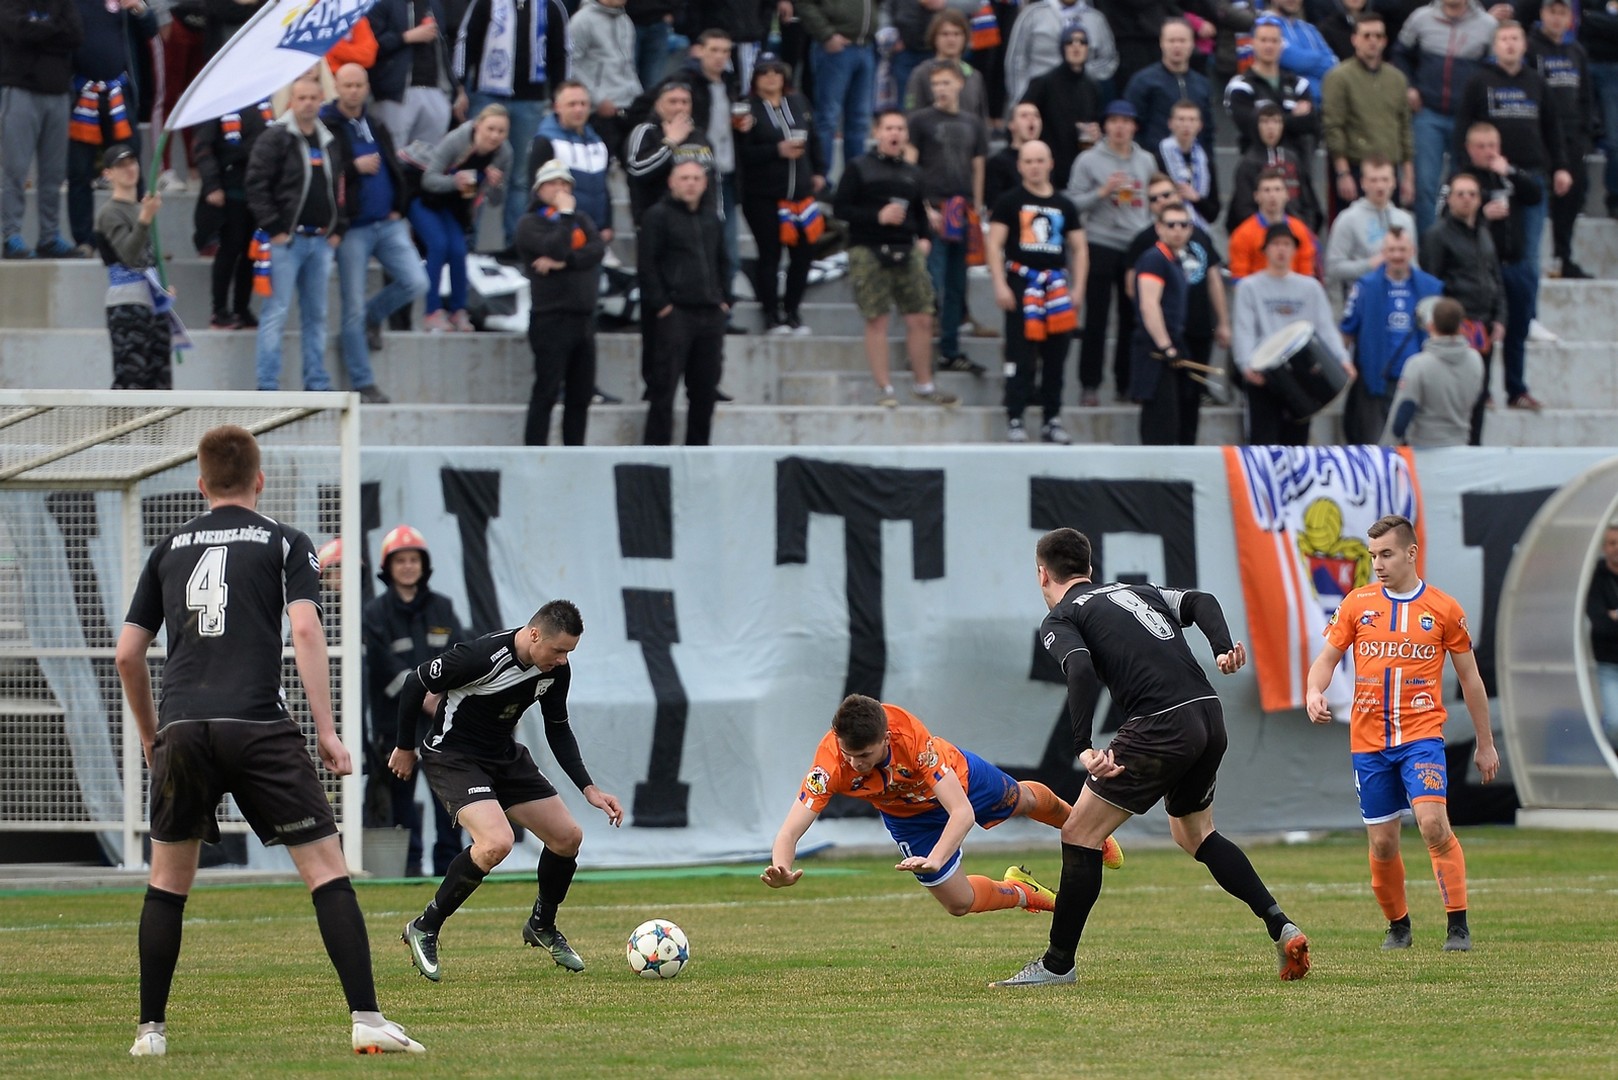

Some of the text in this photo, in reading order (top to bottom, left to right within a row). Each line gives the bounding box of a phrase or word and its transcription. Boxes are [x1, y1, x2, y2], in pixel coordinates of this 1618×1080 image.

[171, 525, 271, 549] NK NEDELIŠĆE
[186, 546, 228, 637] 4
[1106, 589, 1175, 640] 8
[1359, 638, 1436, 660] OSJEČKO
[467, 786, 491, 795] mass
